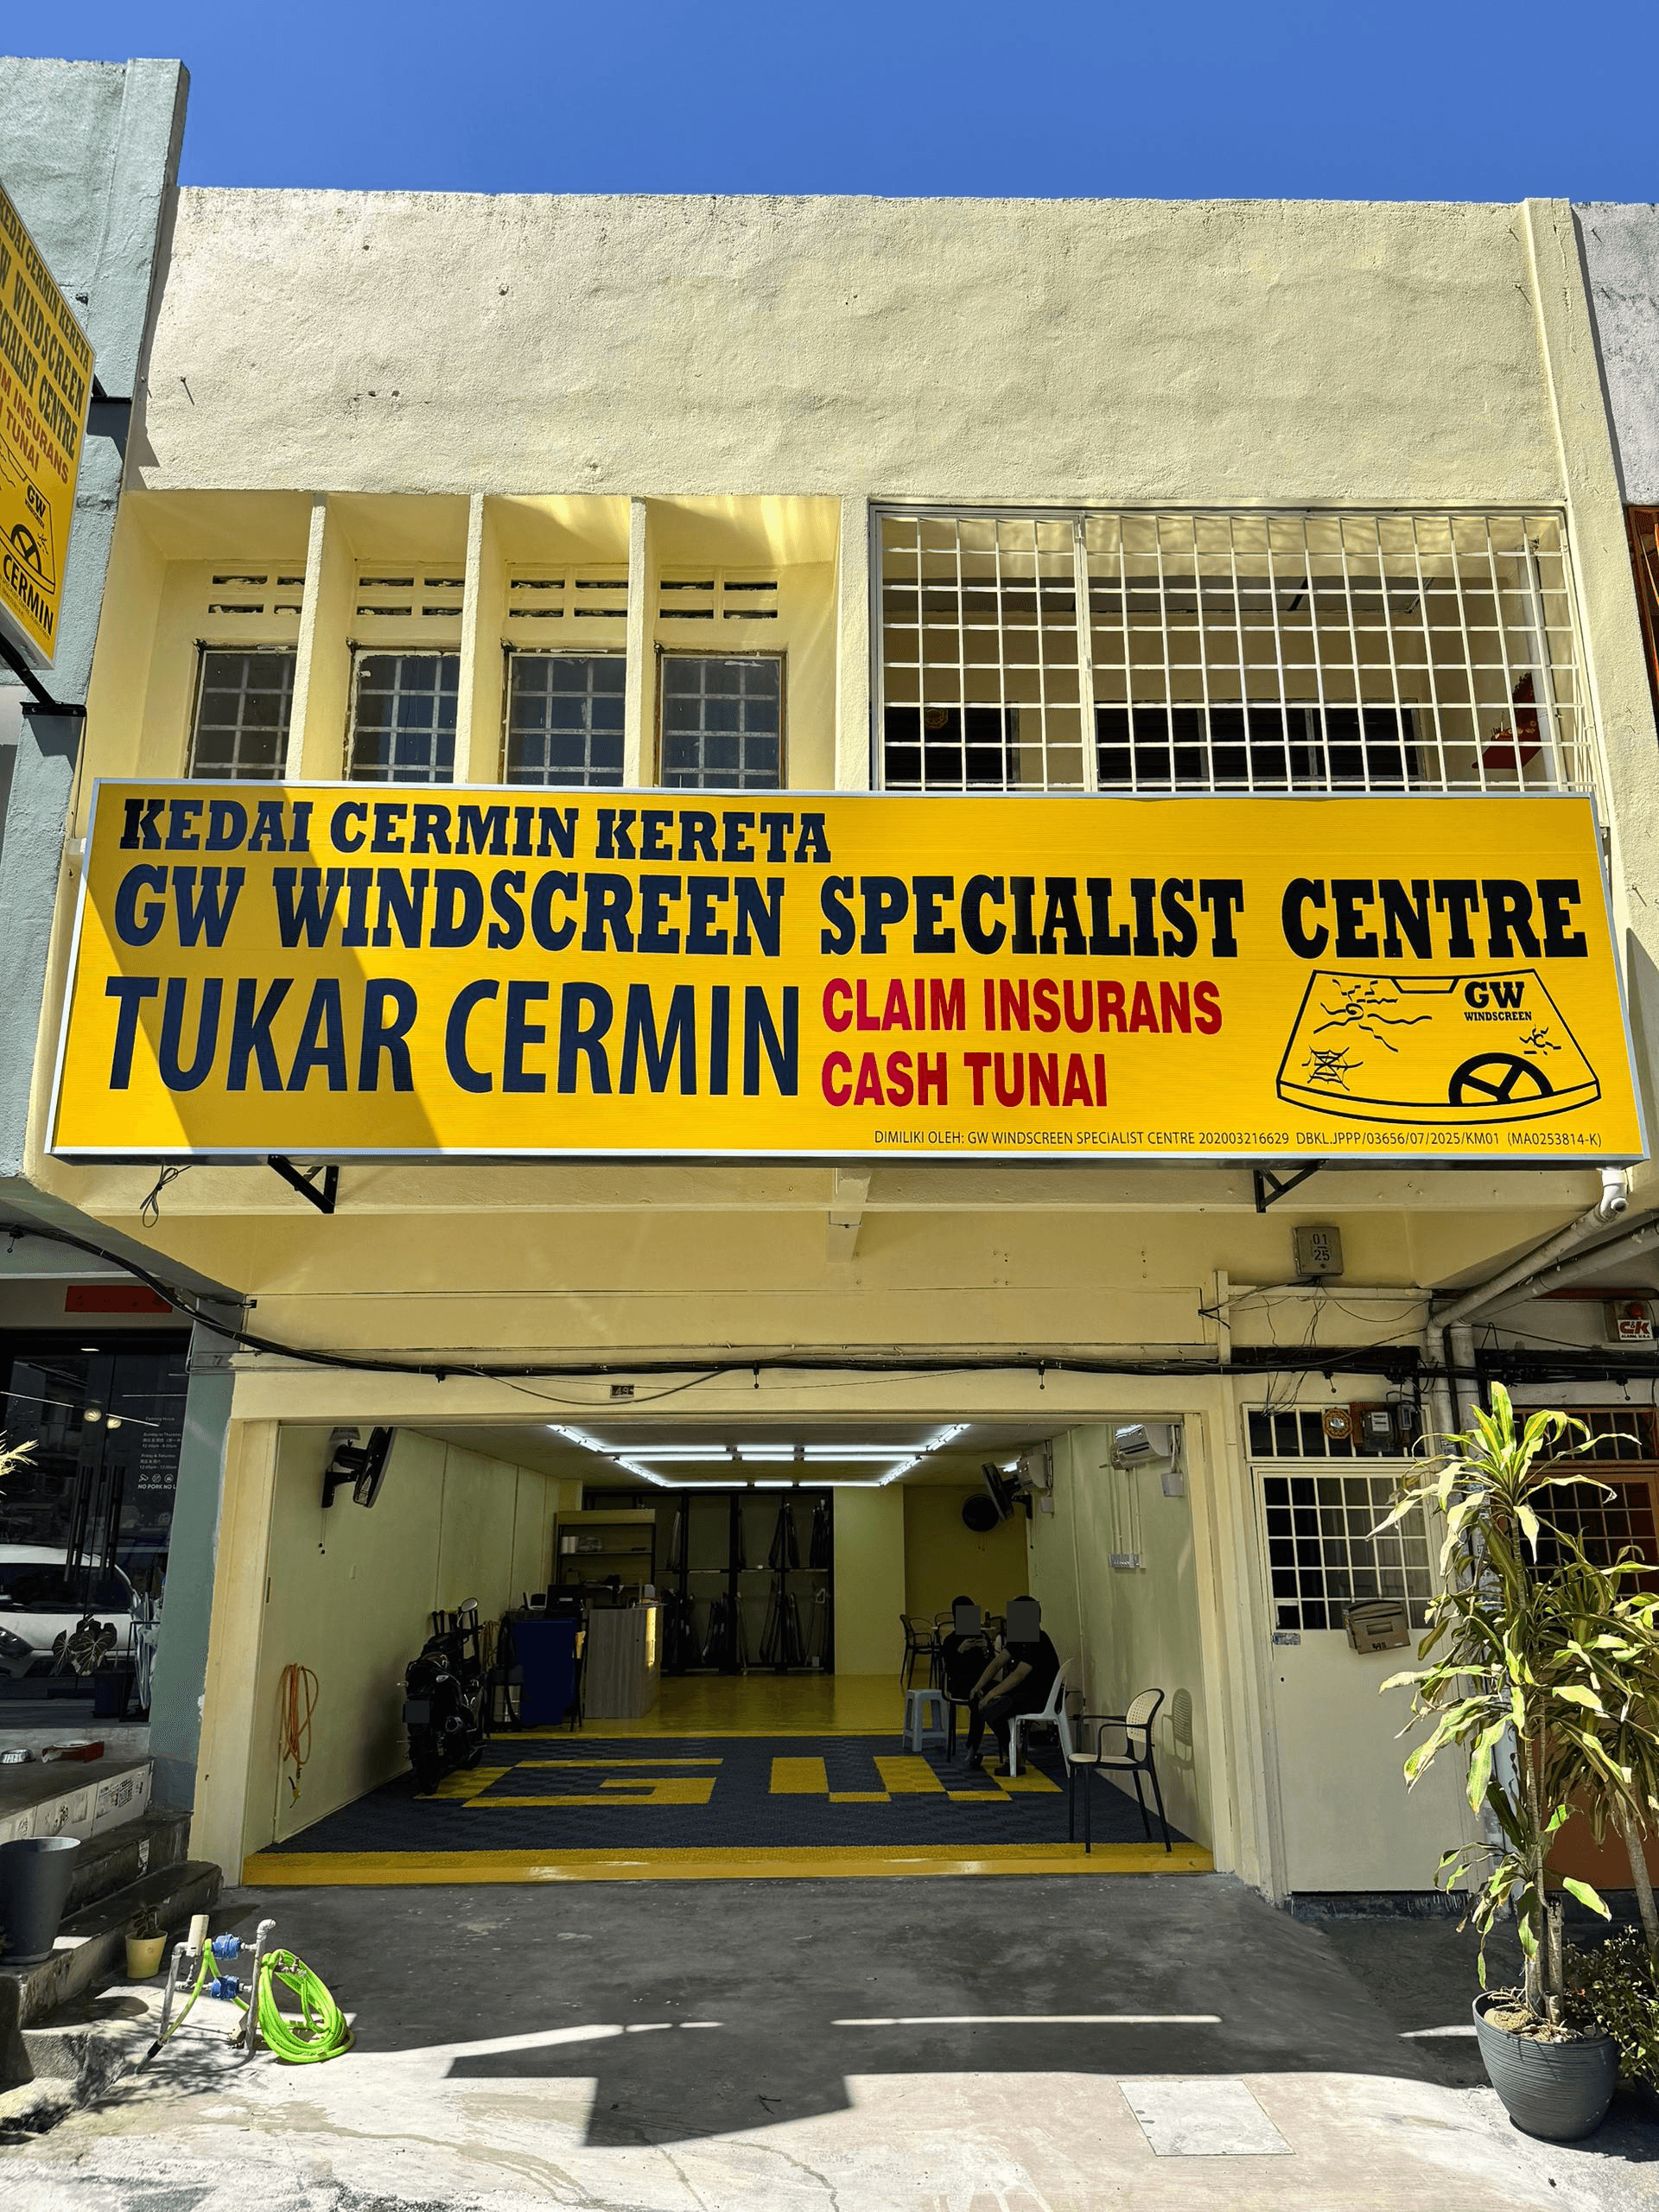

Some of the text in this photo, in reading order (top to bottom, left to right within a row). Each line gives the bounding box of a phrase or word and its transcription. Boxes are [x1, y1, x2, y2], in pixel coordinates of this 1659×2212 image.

[26, 245, 60, 319] CERMIN
[59, 302, 90, 373] KERETA
[14, 269, 86, 418] WINDSCREEN
[0, 304, 78, 461] CIALIST CENTRE
[6, 406, 40, 473] TUNAI
[13, 387, 68, 484] INSURANS
[27, 484, 47, 518] GW
[3, 554, 54, 636] CERMIN
[119, 798, 830, 862] KEDAI CERMIN KERETA
[115, 864, 1587, 959] GW WINDSCREEN SPECIALIST CENTRE
[823, 978, 1222, 1034] CLAIM INSURANS
[1464, 1011, 1531, 1021] WINDSCREEN
[1465, 982, 1524, 1008] GW
[105, 976, 798, 1096] TUKAR CERMIN
[822, 1052, 1107, 1107] CASH TUNAI
[874, 1130, 925, 1144] DIMILIKI
[928, 1130, 964, 1144] OLEH:
[967, 1131, 989, 1144] GW
[991, 1131, 1073, 1145] WINDSCREEN
[1076, 1131, 1144, 1145] SPECIALIST
[1147, 1132, 1196, 1145] CENTRE
[1198, 1132, 1289, 1145] 202003216629
[1507, 1132, 1602, 1147] (MA0253814-K)
[1313, 1233, 1327, 1245] 01
[1313, 1249, 1331, 1261] 25
